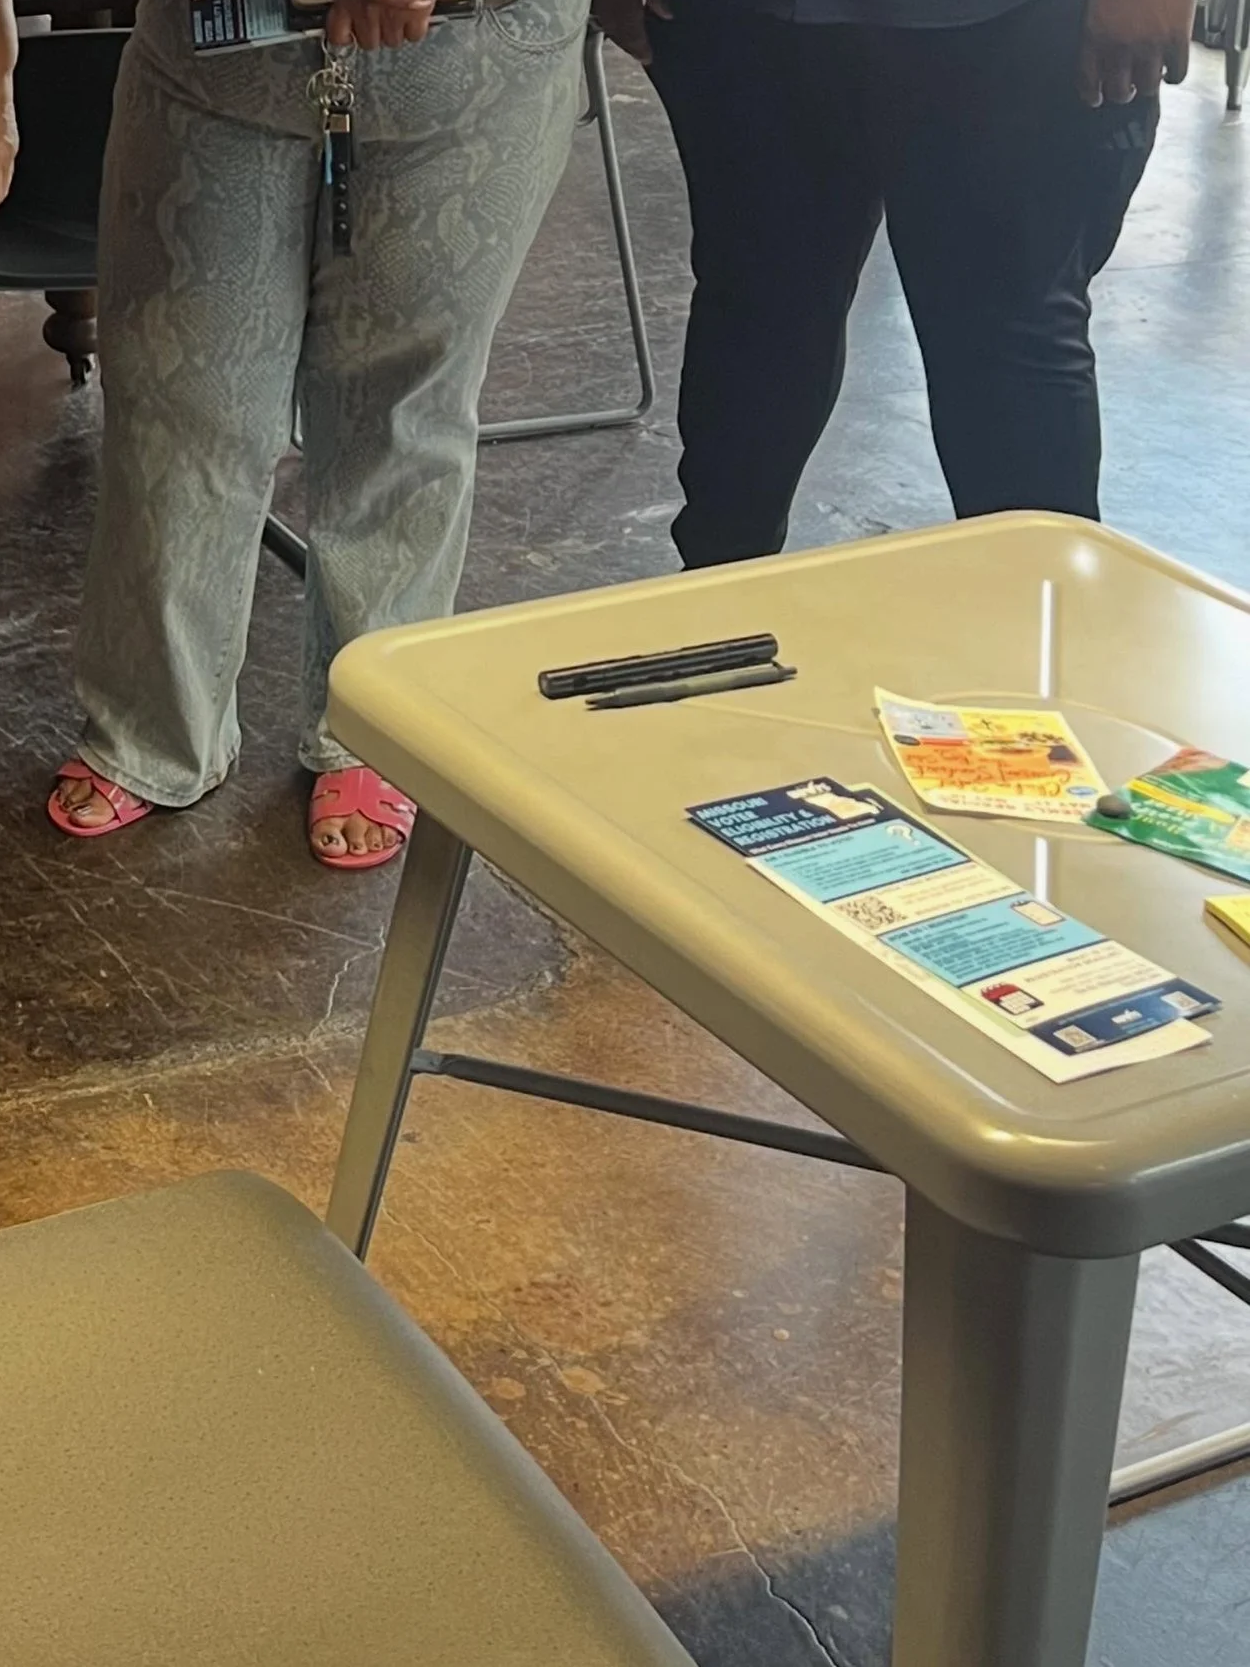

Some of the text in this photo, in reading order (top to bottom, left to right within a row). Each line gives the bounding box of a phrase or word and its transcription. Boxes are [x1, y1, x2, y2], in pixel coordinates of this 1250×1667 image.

[696, 797, 768, 821] MISSOURI
[706, 810, 759, 829] VOTER
[719, 811, 800, 838] ELIGIBILITY
[732, 814, 837, 847] REGISTRATION
